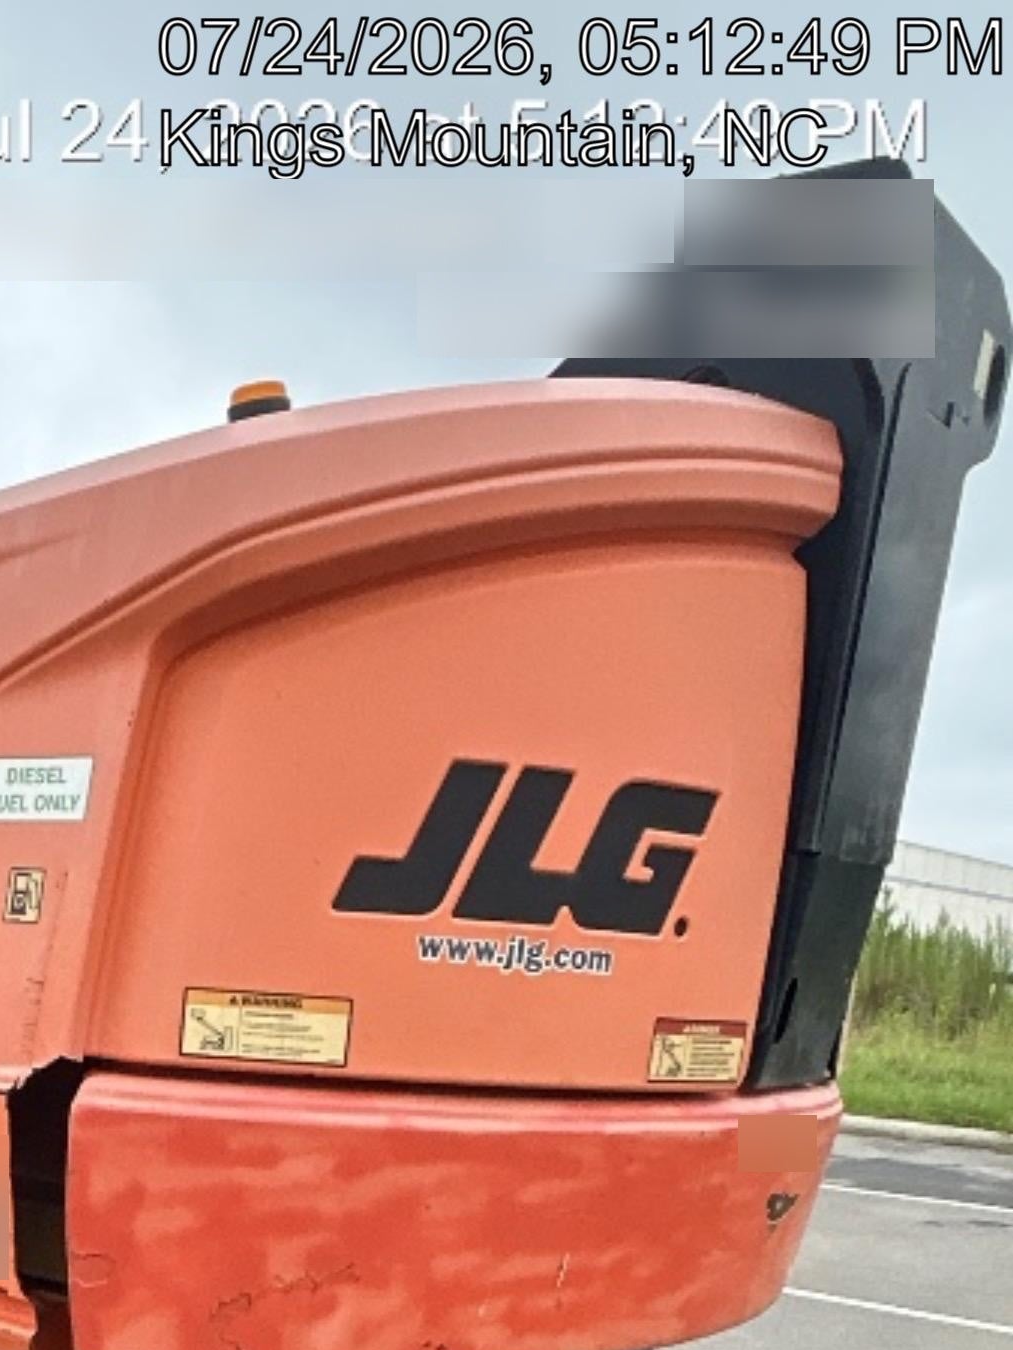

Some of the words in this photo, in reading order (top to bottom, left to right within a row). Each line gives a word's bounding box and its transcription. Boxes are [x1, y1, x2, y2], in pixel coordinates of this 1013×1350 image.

[6, 766, 67, 785] DIESEL
[34, 793, 81, 813] ONLY
[418, 935, 613, 974] www.jlg.com
